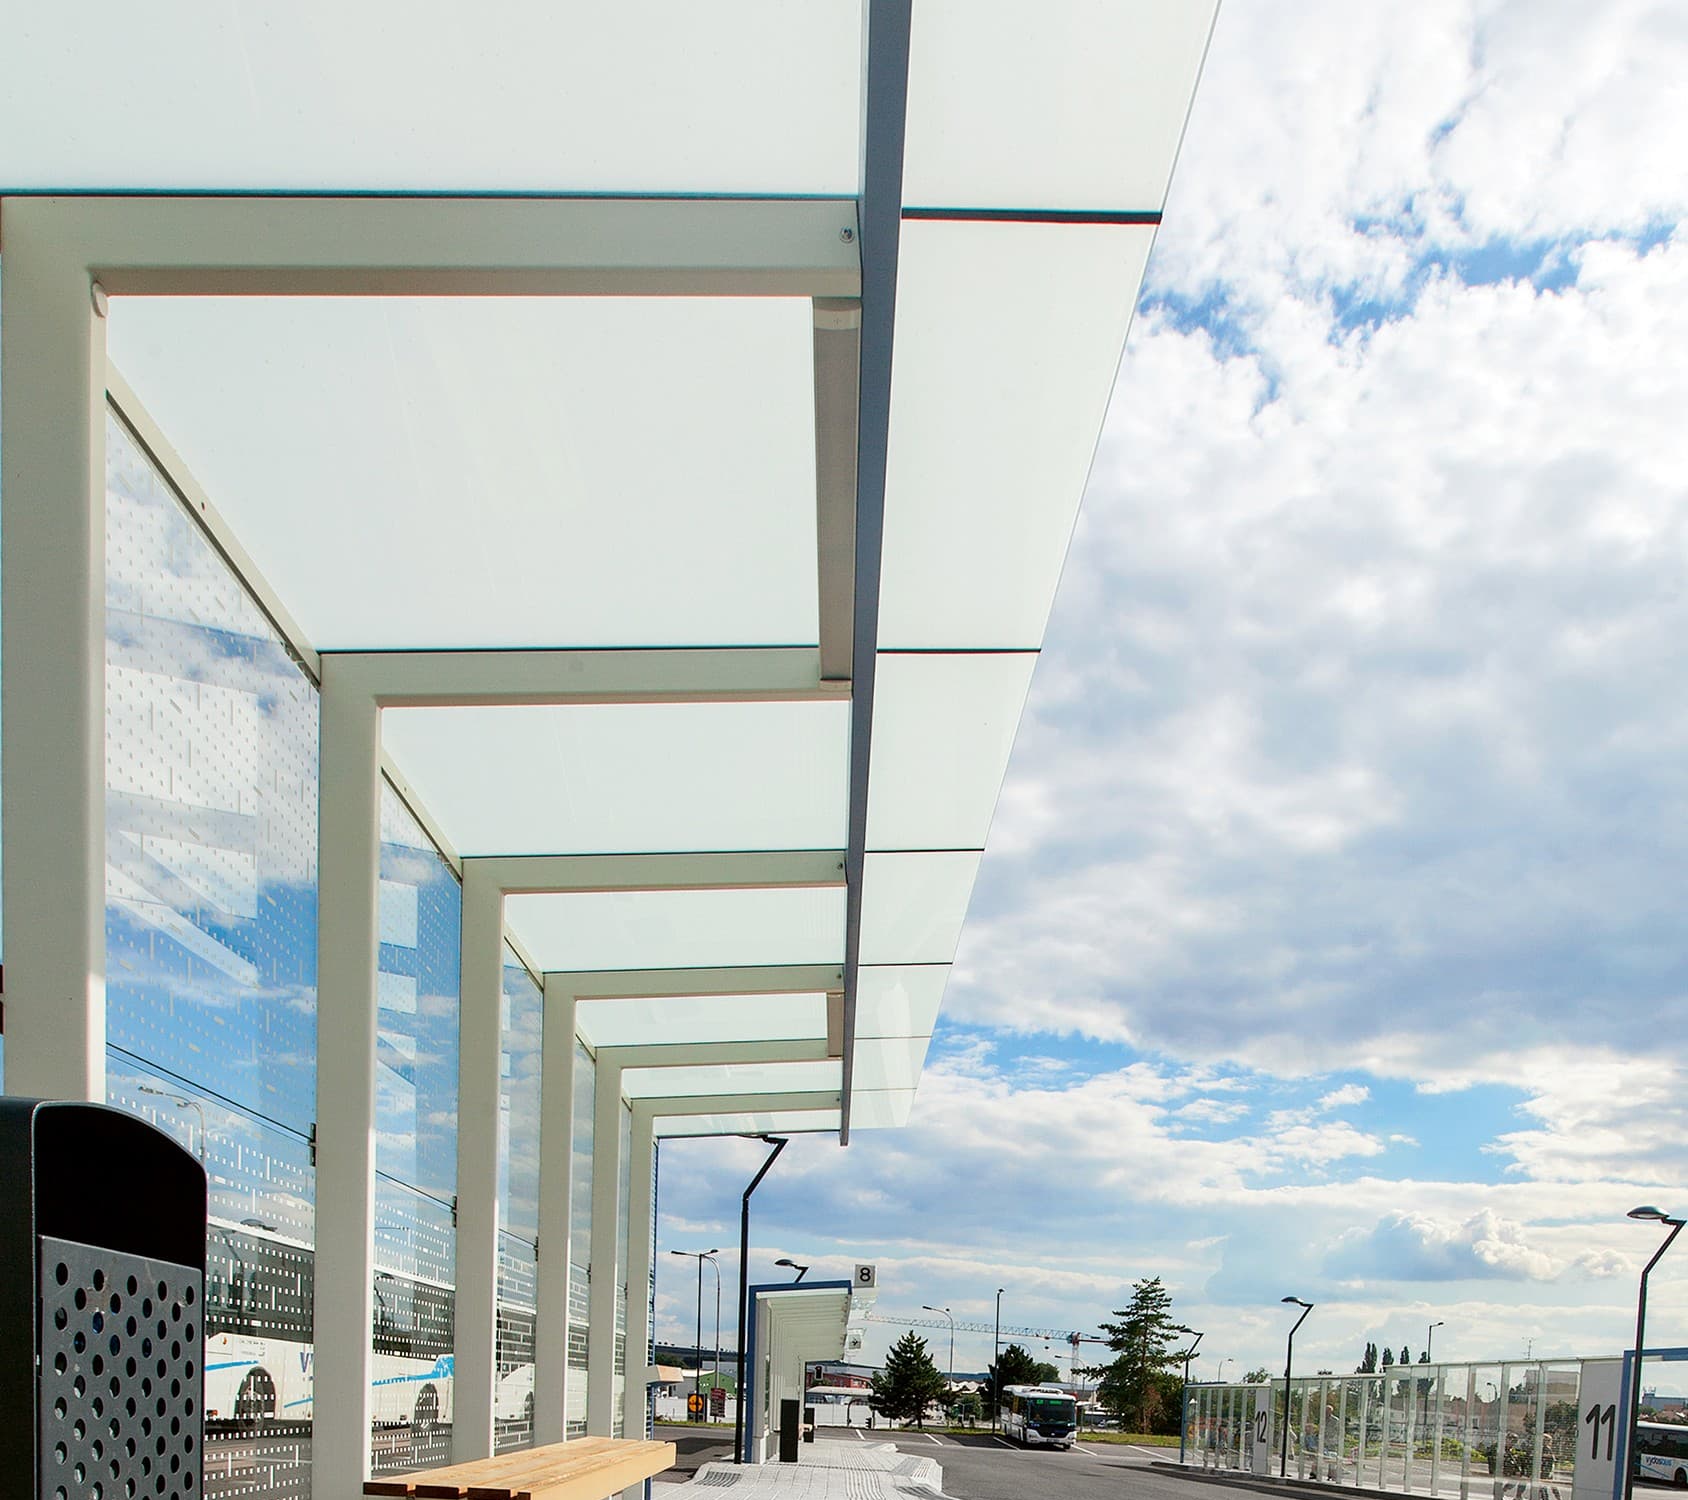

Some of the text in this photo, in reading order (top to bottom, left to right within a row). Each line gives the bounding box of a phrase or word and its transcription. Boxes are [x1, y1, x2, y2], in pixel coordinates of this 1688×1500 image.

[860, 1267, 871, 1282] 8
[1256, 1411, 1267, 1443] 12
[1585, 1404, 1616, 1461] 11
